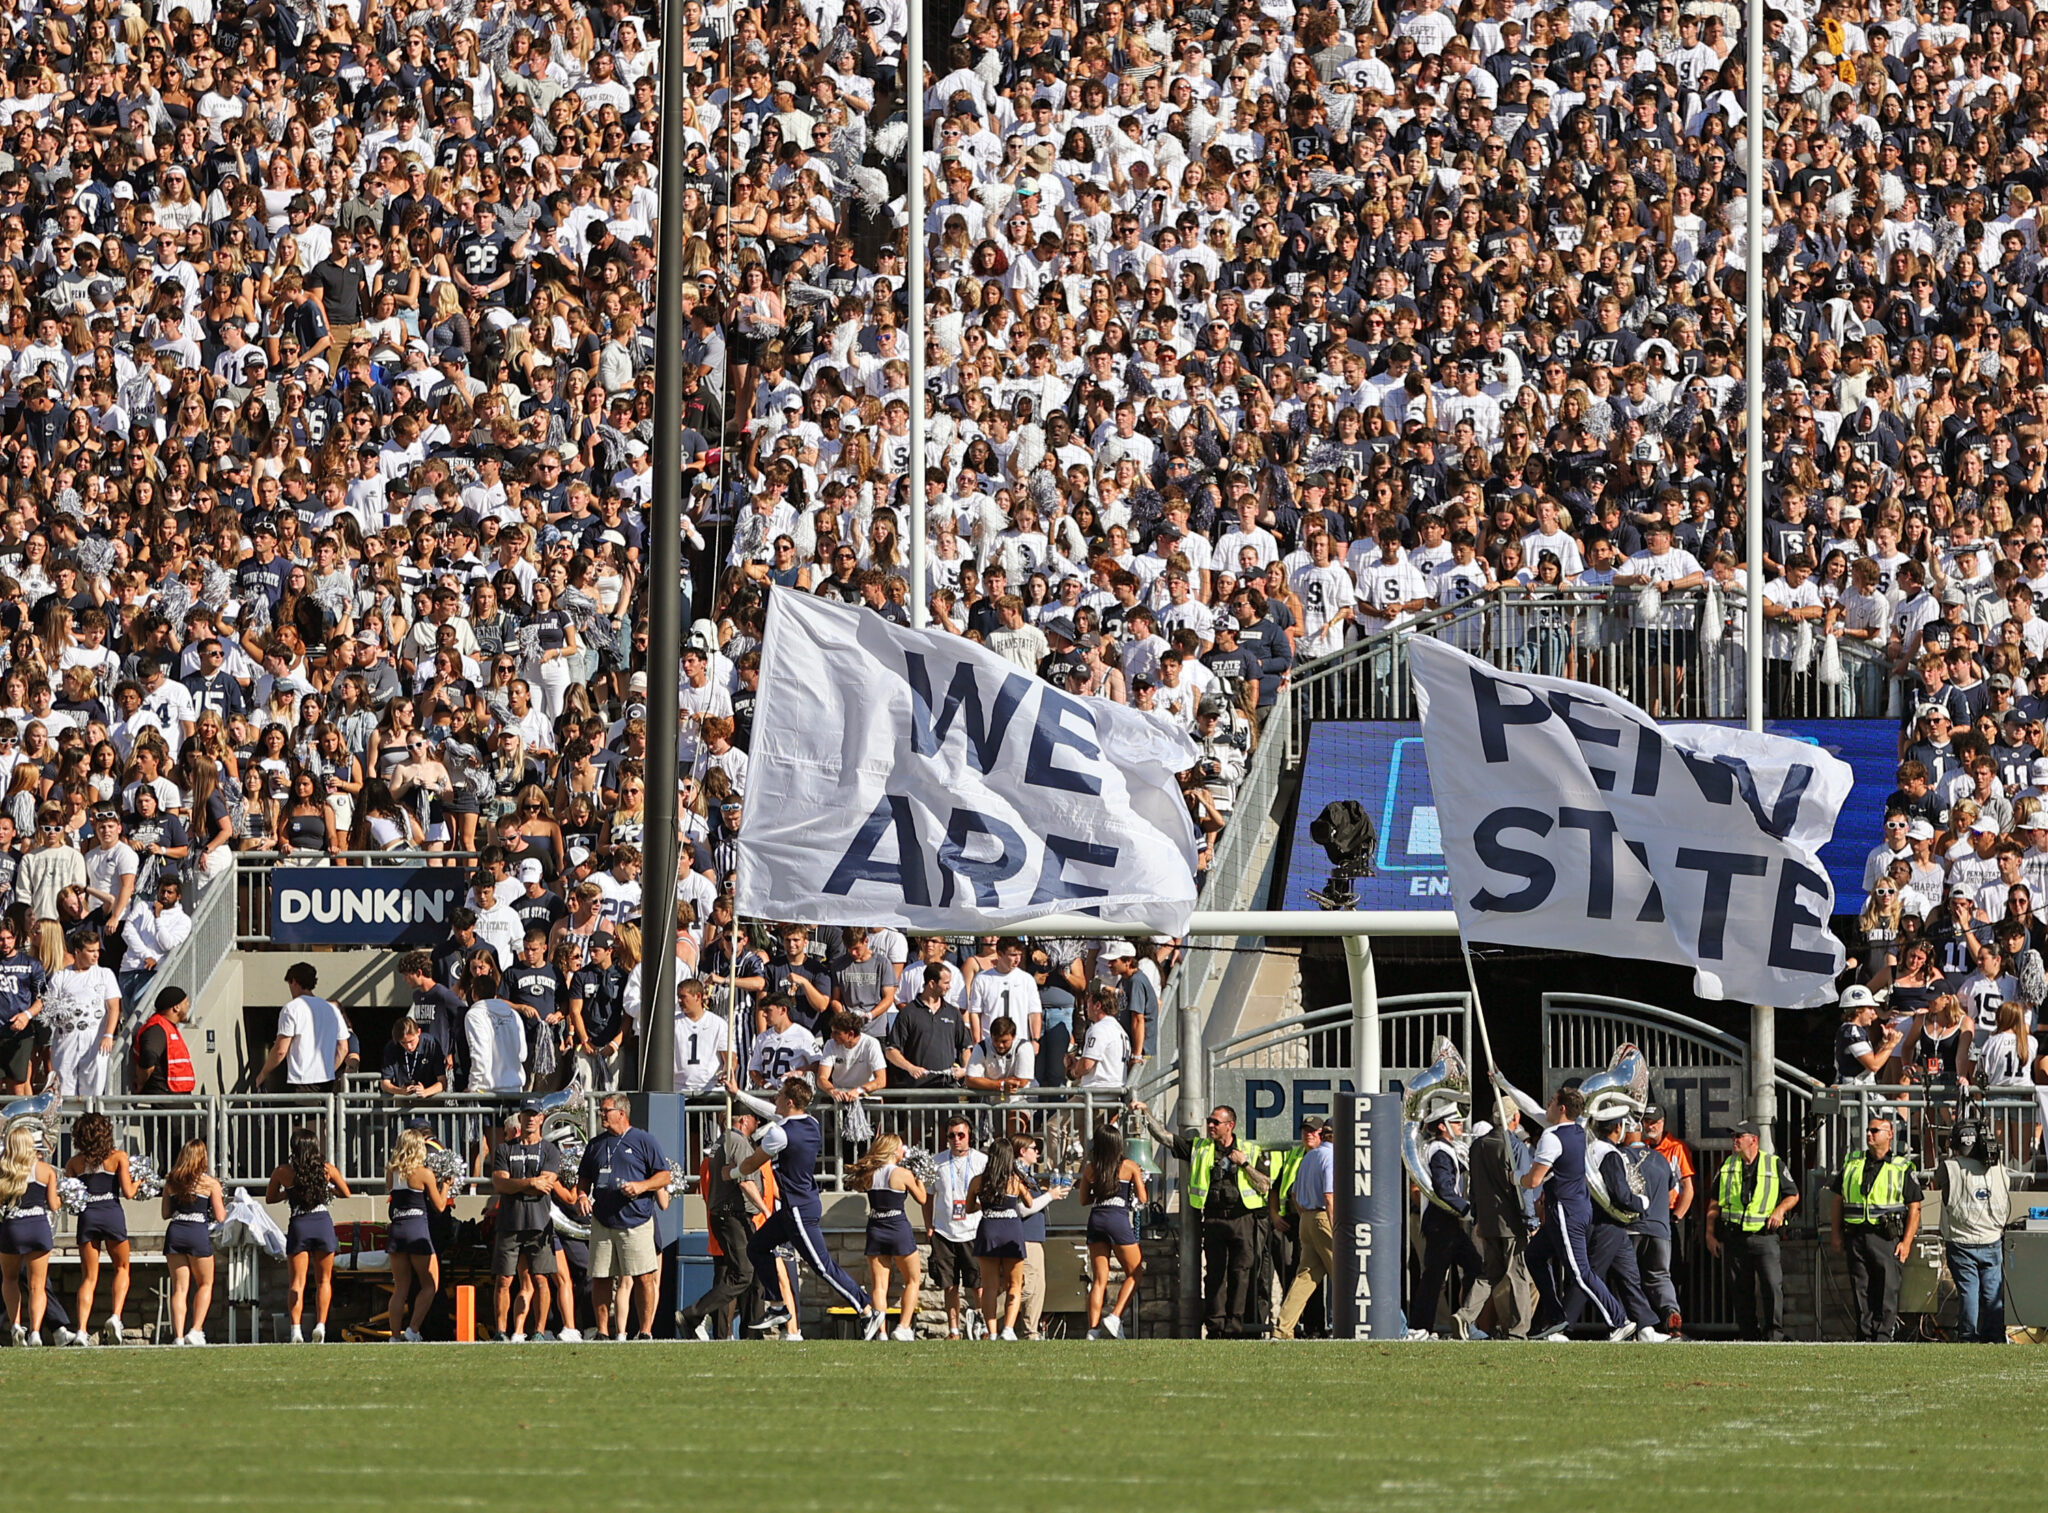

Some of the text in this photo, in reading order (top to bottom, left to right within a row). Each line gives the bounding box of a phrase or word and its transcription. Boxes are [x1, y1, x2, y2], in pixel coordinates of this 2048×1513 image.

[1355, 71, 1367, 89] S
[1235, 148, 1248, 166] S
[1297, 138, 1311, 160] S
[1243, 204, 1256, 223] S
[1897, 232, 1910, 249] S
[465, 245, 499, 274] 26
[951, 259, 963, 277] S
[71, 290, 87, 299] PENN
[1180, 303, 1193, 322] S
[1593, 341, 1609, 361] S
[221, 361, 239, 386] 11
[928, 377, 943, 396] S
[1220, 395, 1234, 411] S
[893, 447, 908, 467] S
[633, 486, 642, 512] 1
[1786, 533, 1804, 554] S
[242, 571, 280, 586] PENN STATE
[1383, 578, 1400, 601] S
[1455, 578, 1471, 600] S
[1876, 572, 1891, 594] S
[1307, 581, 1323, 605] S
[997, 638, 1034, 651] PENN STATE
[1211, 660, 1241, 670] STATE
[191, 690, 225, 722] 15
[904, 650, 1102, 796] WE
[1932, 756, 1945, 788] 1
[2003, 764, 2028, 790] 11
[822, 795, 1119, 916] ARE
[1967, 870, 1984, 878] PENN
[1410, 876, 1452, 896] EN
[280, 888, 455, 924] DUNKIN'
[531, 906, 551, 921] STATE
[690, 898, 702, 929] 1
[1944, 942, 1968, 973] 11
[517, 975, 556, 990] PENN STATE
[1000, 989, 1010, 1018] 1
[1975, 992, 2001, 1028] 15
[687, 1033, 700, 1065] 1
[761, 1046, 794, 1079] 26
[2004, 1052, 2024, 1077] 11
[1354, 1097, 1372, 1197] PENN
[1355, 1223, 1372, 1339] STATE
